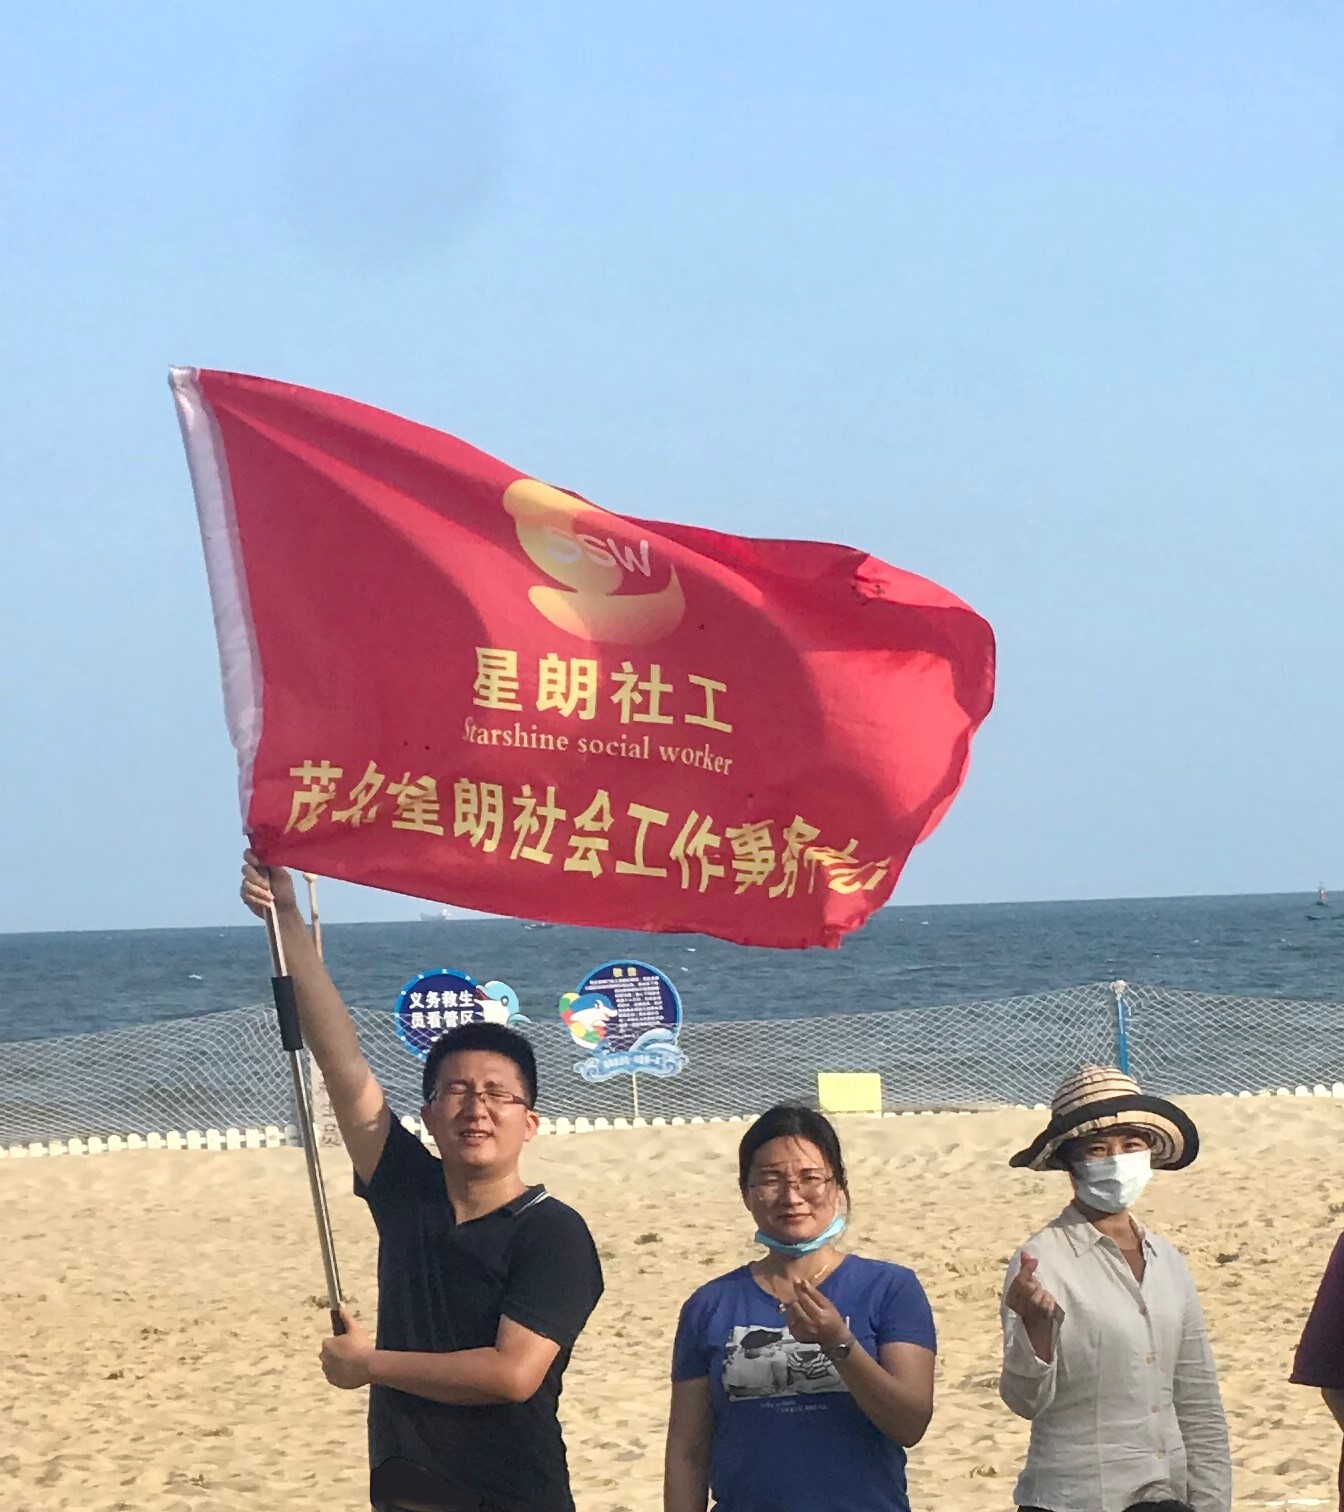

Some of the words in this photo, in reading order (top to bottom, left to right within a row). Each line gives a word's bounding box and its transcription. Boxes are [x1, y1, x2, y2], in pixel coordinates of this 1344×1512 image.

[544, 527, 651, 577] SSW
[472, 646, 733, 734] 星朗社工
[463, 716, 569, 751] Starshine
[577, 733, 650, 760] social
[658, 744, 733, 776] worker
[408, 990, 475, 1009] 义务救生
